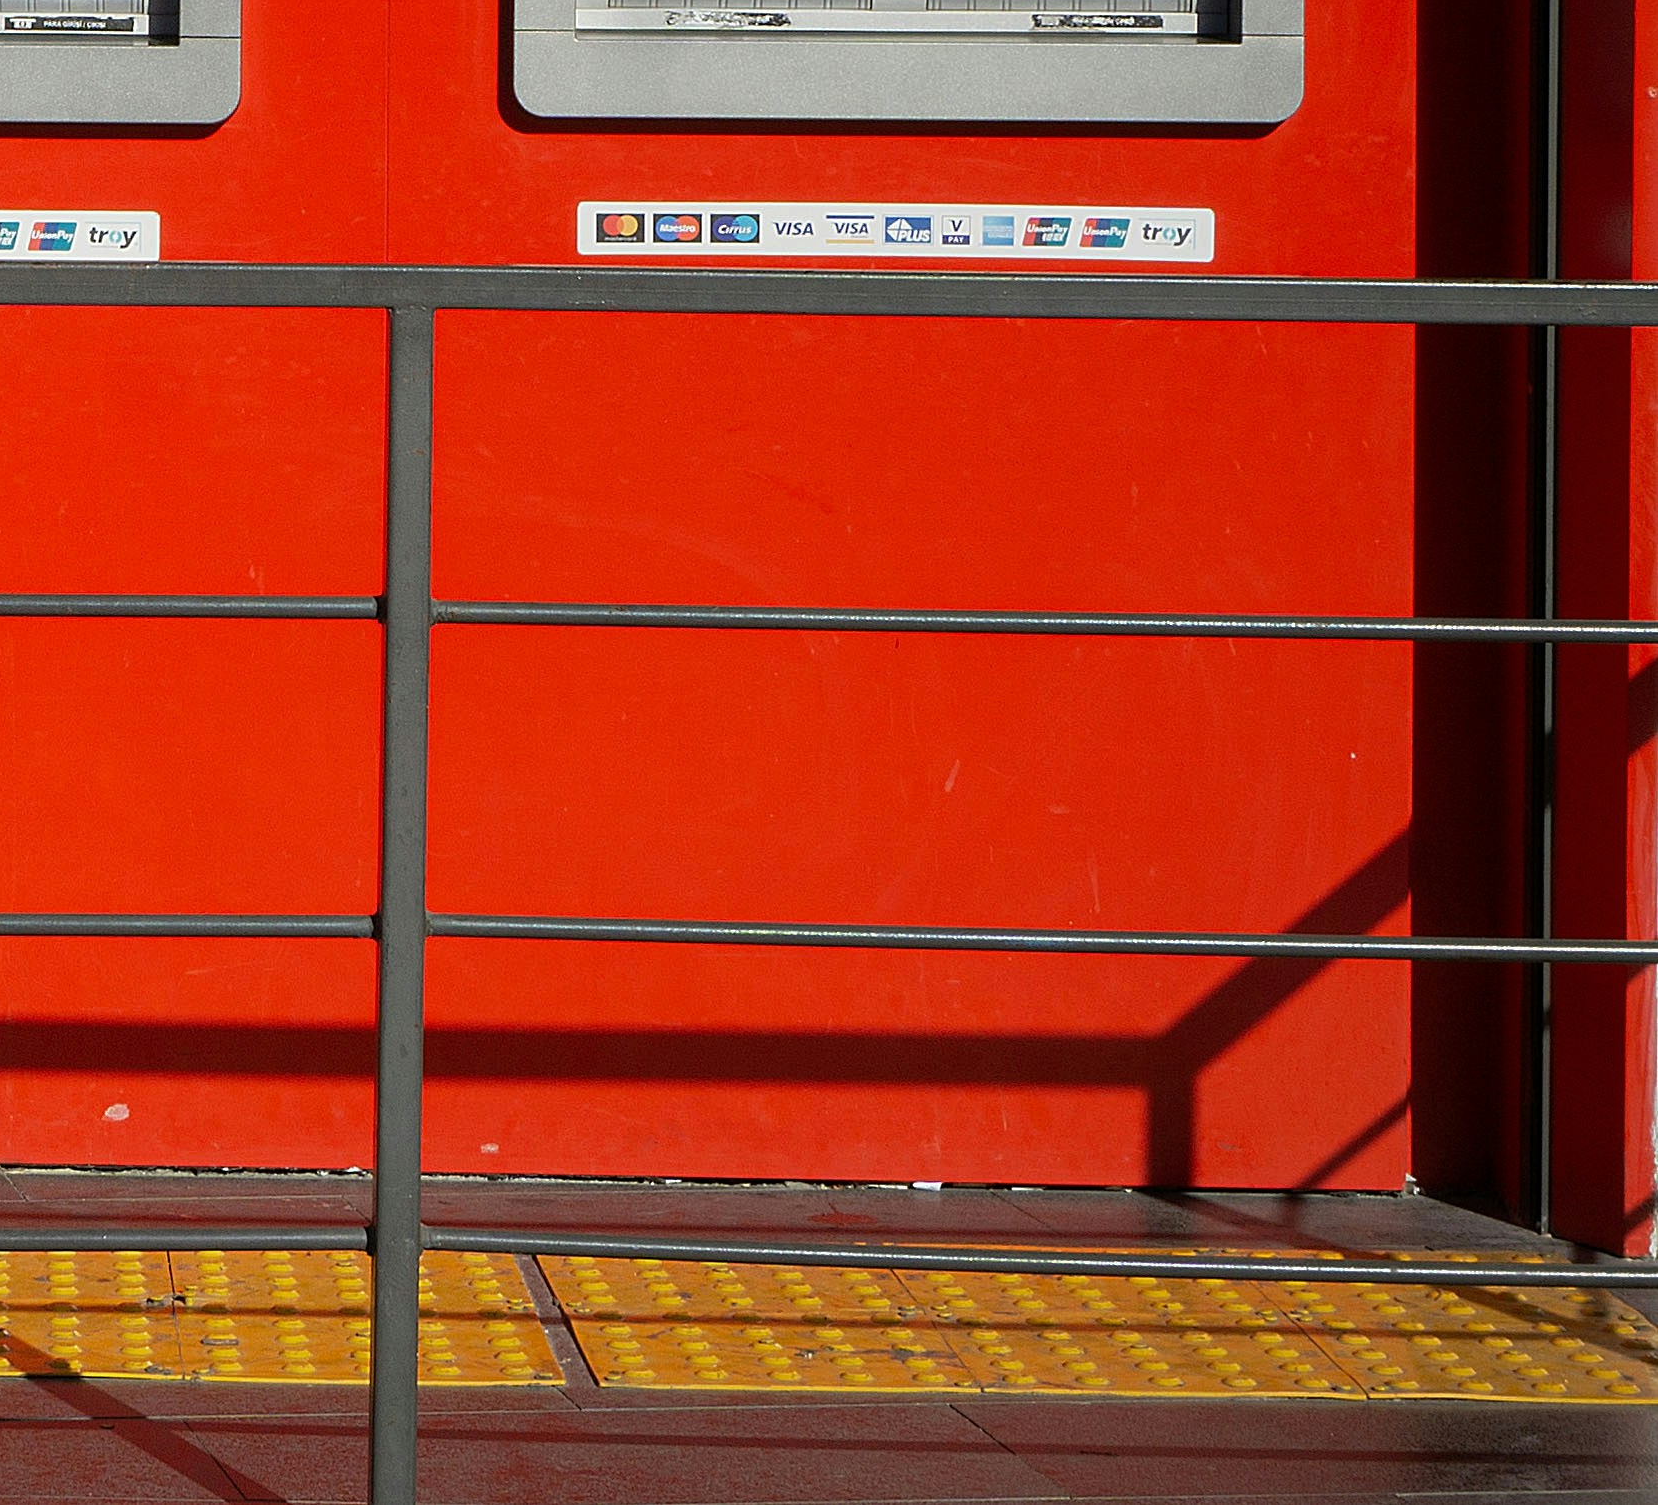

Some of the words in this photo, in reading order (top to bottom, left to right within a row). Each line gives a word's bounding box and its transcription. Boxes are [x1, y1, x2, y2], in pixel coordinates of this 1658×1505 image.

[31, 229, 74, 243] UnionPay
[89, 226, 138, 249] troy
[659, 223, 696, 233] Maestro
[717, 223, 752, 235] Cirrus
[774, 222, 814, 236] VISA
[833, 222, 869, 234] VISA
[898, 228, 930, 242] PLUS
[1027, 223, 1068, 236] UnionPay
[1084, 225, 1127, 239] UnionPay
[1142, 223, 1192, 247] troy
